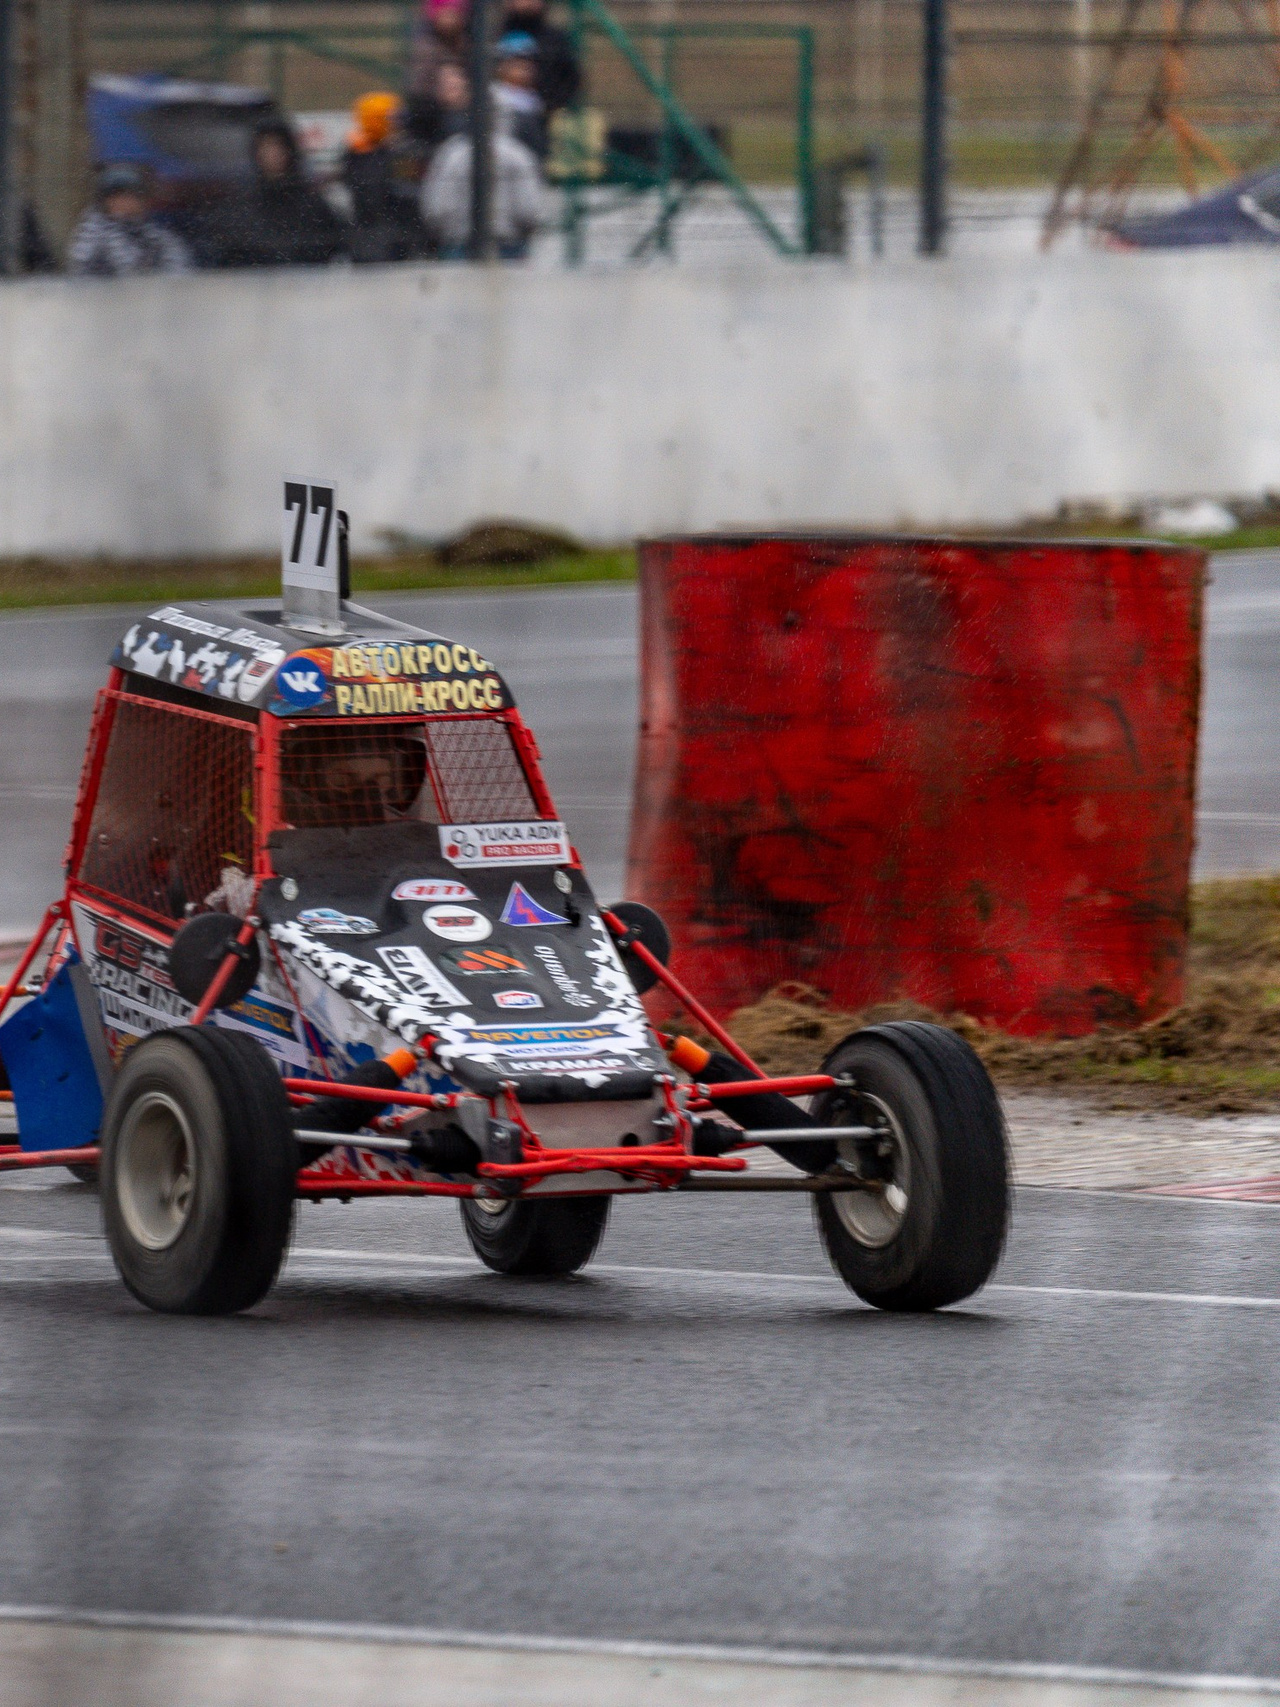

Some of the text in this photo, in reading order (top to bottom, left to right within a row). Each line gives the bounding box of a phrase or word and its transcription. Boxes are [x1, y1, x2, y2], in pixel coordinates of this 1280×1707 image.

[283, 481, 334, 568] 77
[335, 677, 503, 715] РАЛЛИ-КРОСС
[474, 825, 525, 841] YUKA
[385, 948, 451, 1007] NWB
[469, 1027, 614, 1043] RAVENOL
[508, 1058, 626, 1071] КРАМАР
